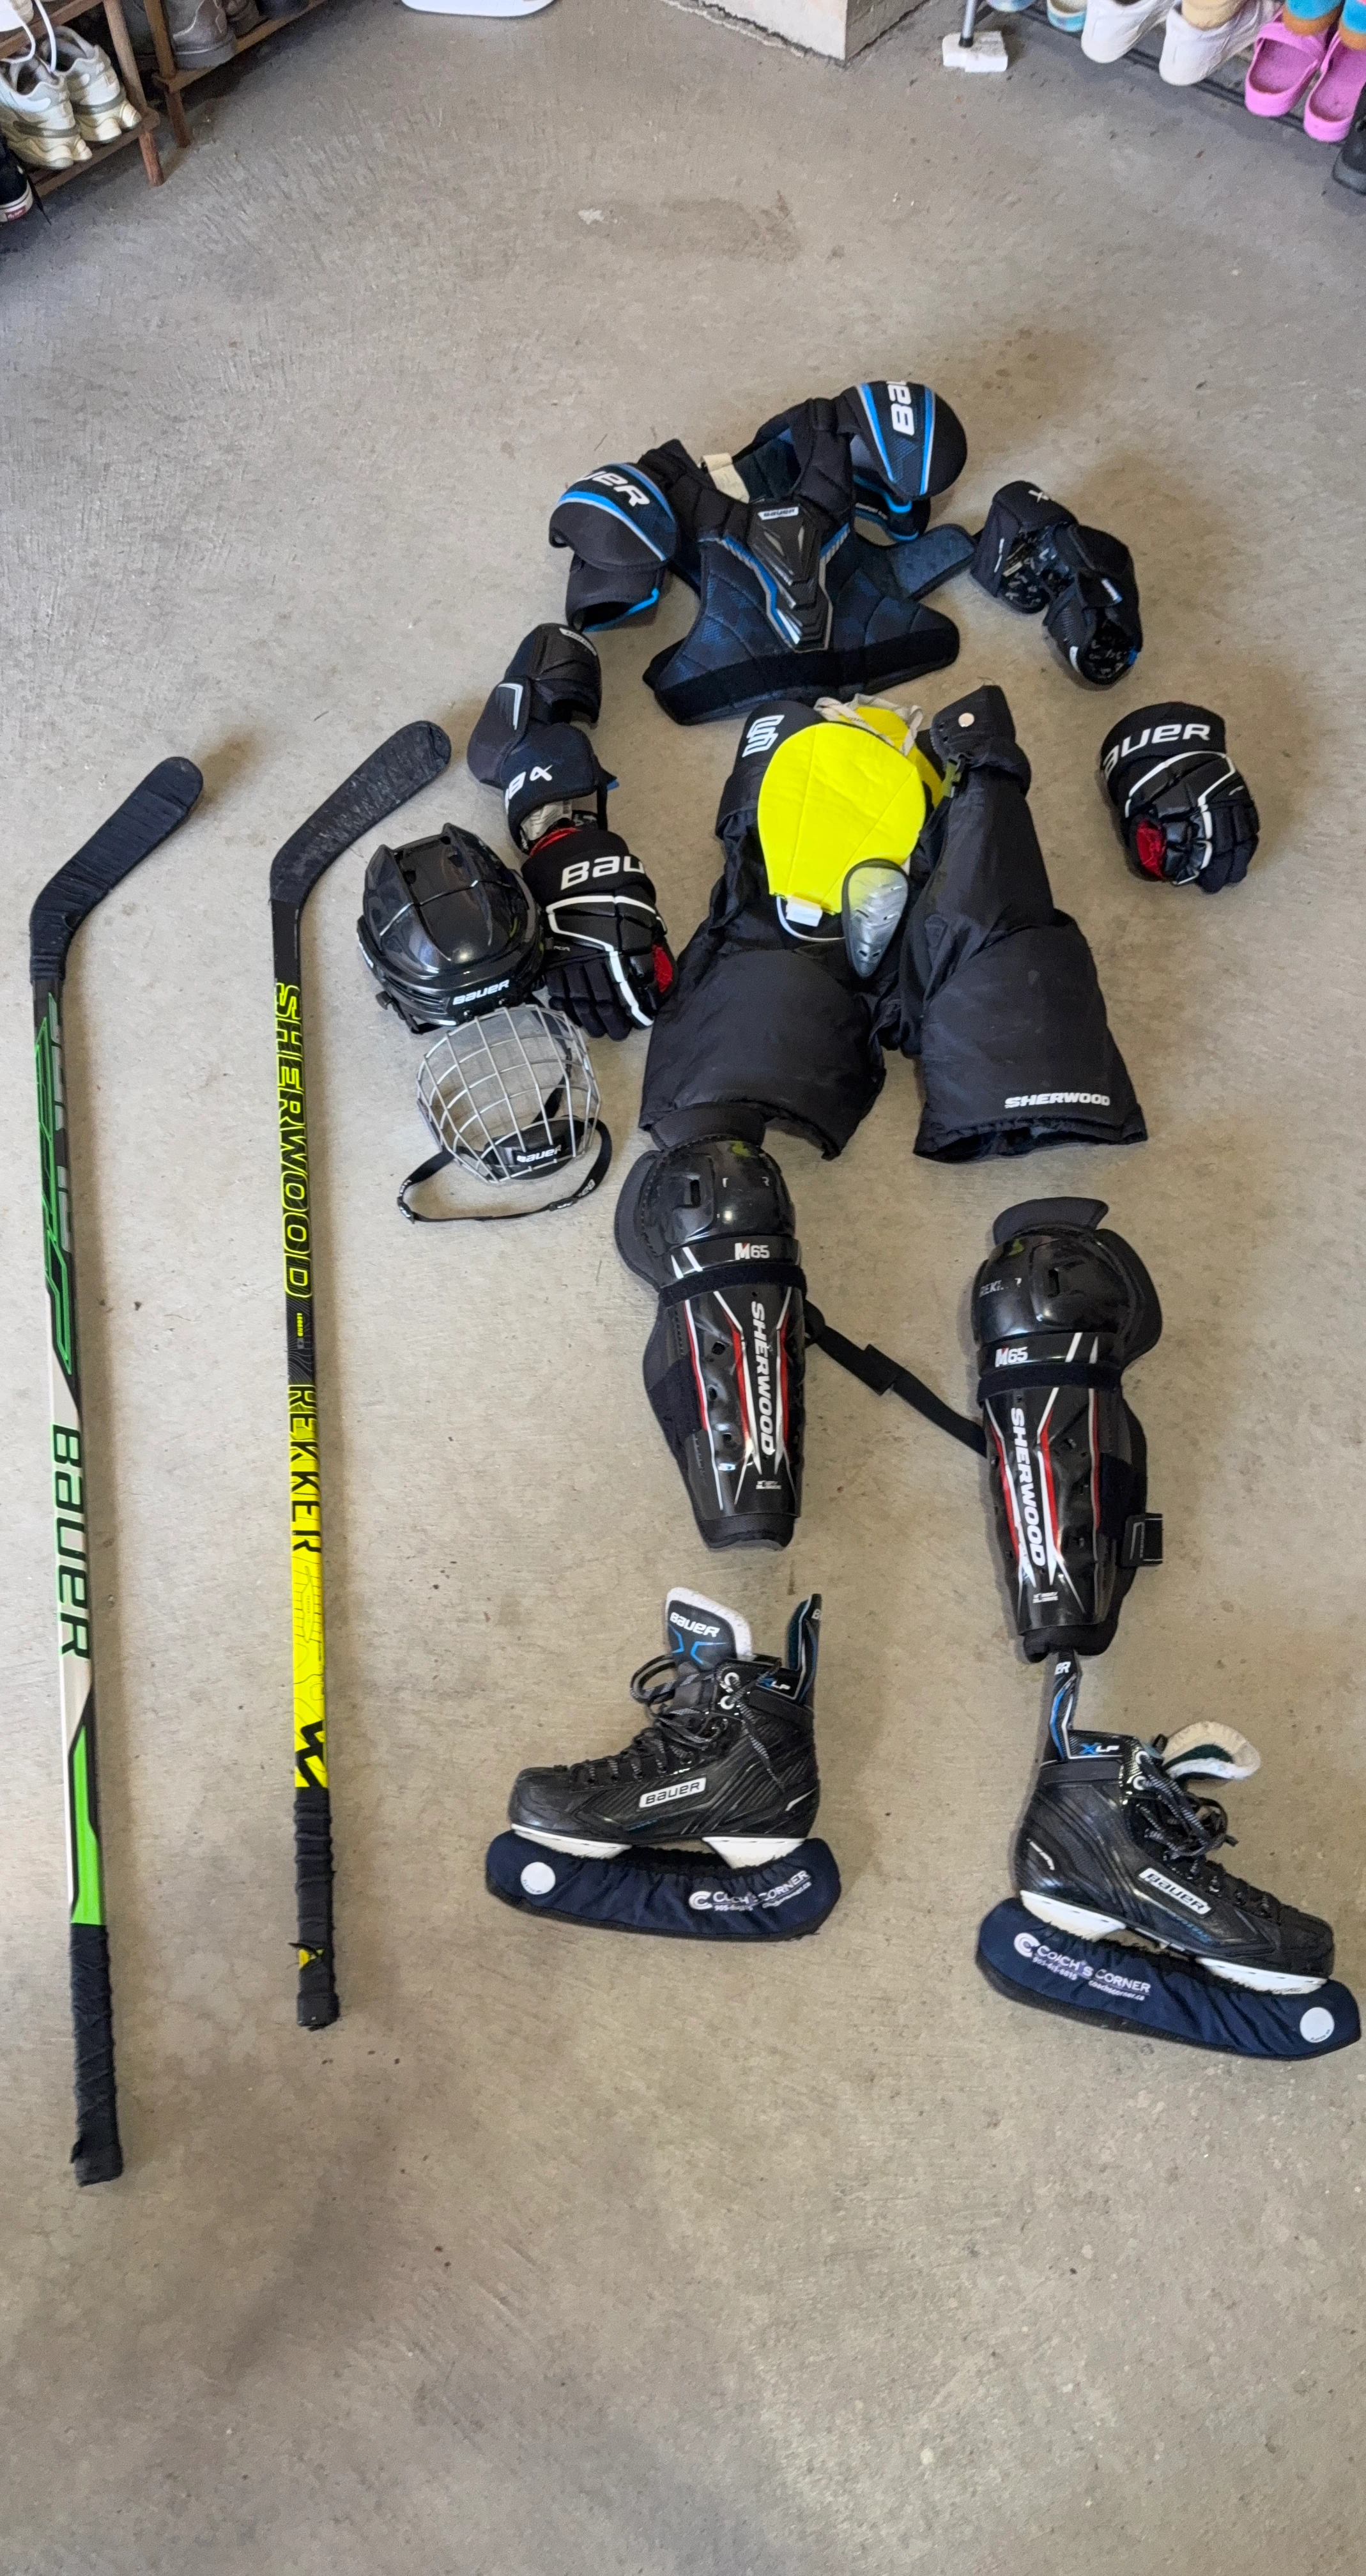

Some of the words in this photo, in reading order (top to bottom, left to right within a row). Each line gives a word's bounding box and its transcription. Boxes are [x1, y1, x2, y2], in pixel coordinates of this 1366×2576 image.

[452, 979, 510, 1006] BAUER
[1004, 1092, 1110, 1108] SHERWOOD
[275, 982, 312, 1298] SHERWOOD
[517, 1144, 562, 1162] BAUER
[735, 1242, 771, 1261] M65
[995, 1346, 1028, 1367] M65
[751, 1301, 776, 1456] SHERWOOD
[288, 1384, 322, 1554] REKKER
[1011, 1407, 1046, 1567] SHERWOOD
[51, 1423, 91, 1659] BAUER
[670, 1612, 721, 1637] BAUER
[645, 1782, 700, 1804] BAUER
[1146, 1873, 1204, 1910] BAUER
[1094, 1968, 1151, 1993] CORNER
